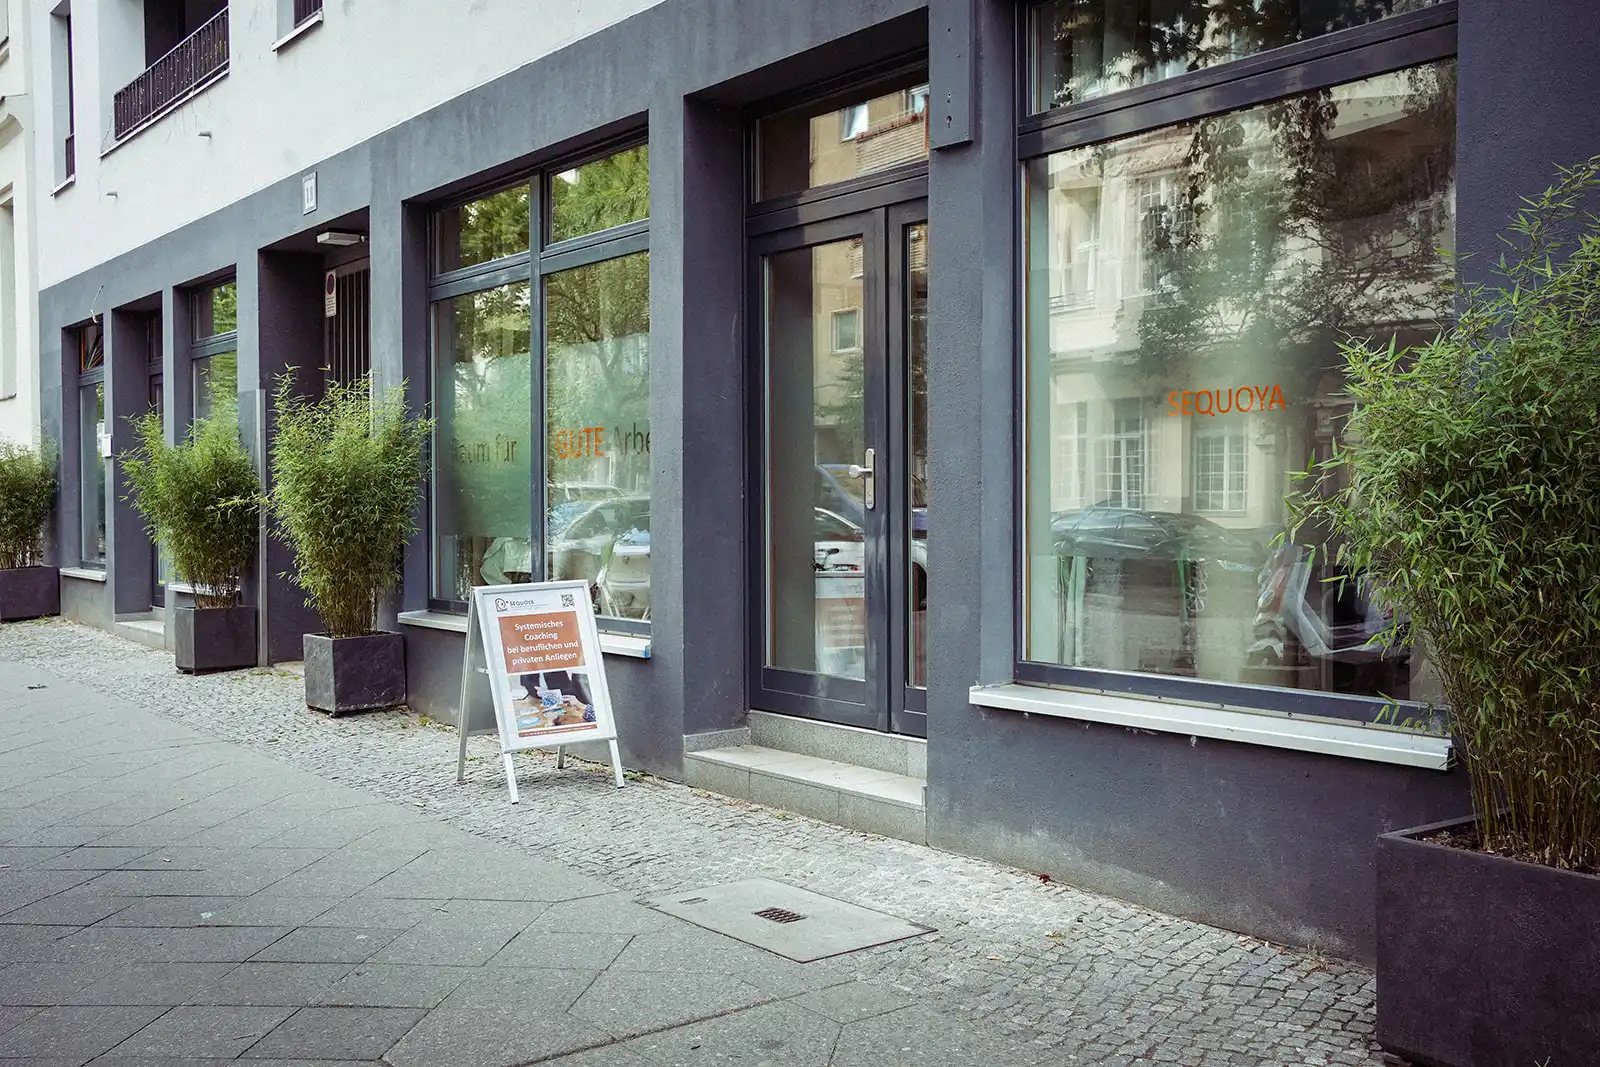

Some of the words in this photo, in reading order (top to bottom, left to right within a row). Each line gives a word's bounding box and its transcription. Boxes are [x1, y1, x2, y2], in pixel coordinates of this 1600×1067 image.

[1167, 384, 1287, 417] SEQUOYA
[495, 432, 518, 463] für
[555, 426, 605, 460] GUTE
[509, 599, 535, 607] SEQUOYA
[514, 620, 564, 632] Systemisches
[524, 631, 559, 641] Coaching
[506, 645, 519, 654] bei
[519, 642, 563, 652] beruflichen
[564, 640, 579, 649] und
[511, 654, 544, 666] privaten
[544, 652, 578, 662] Anliegen
